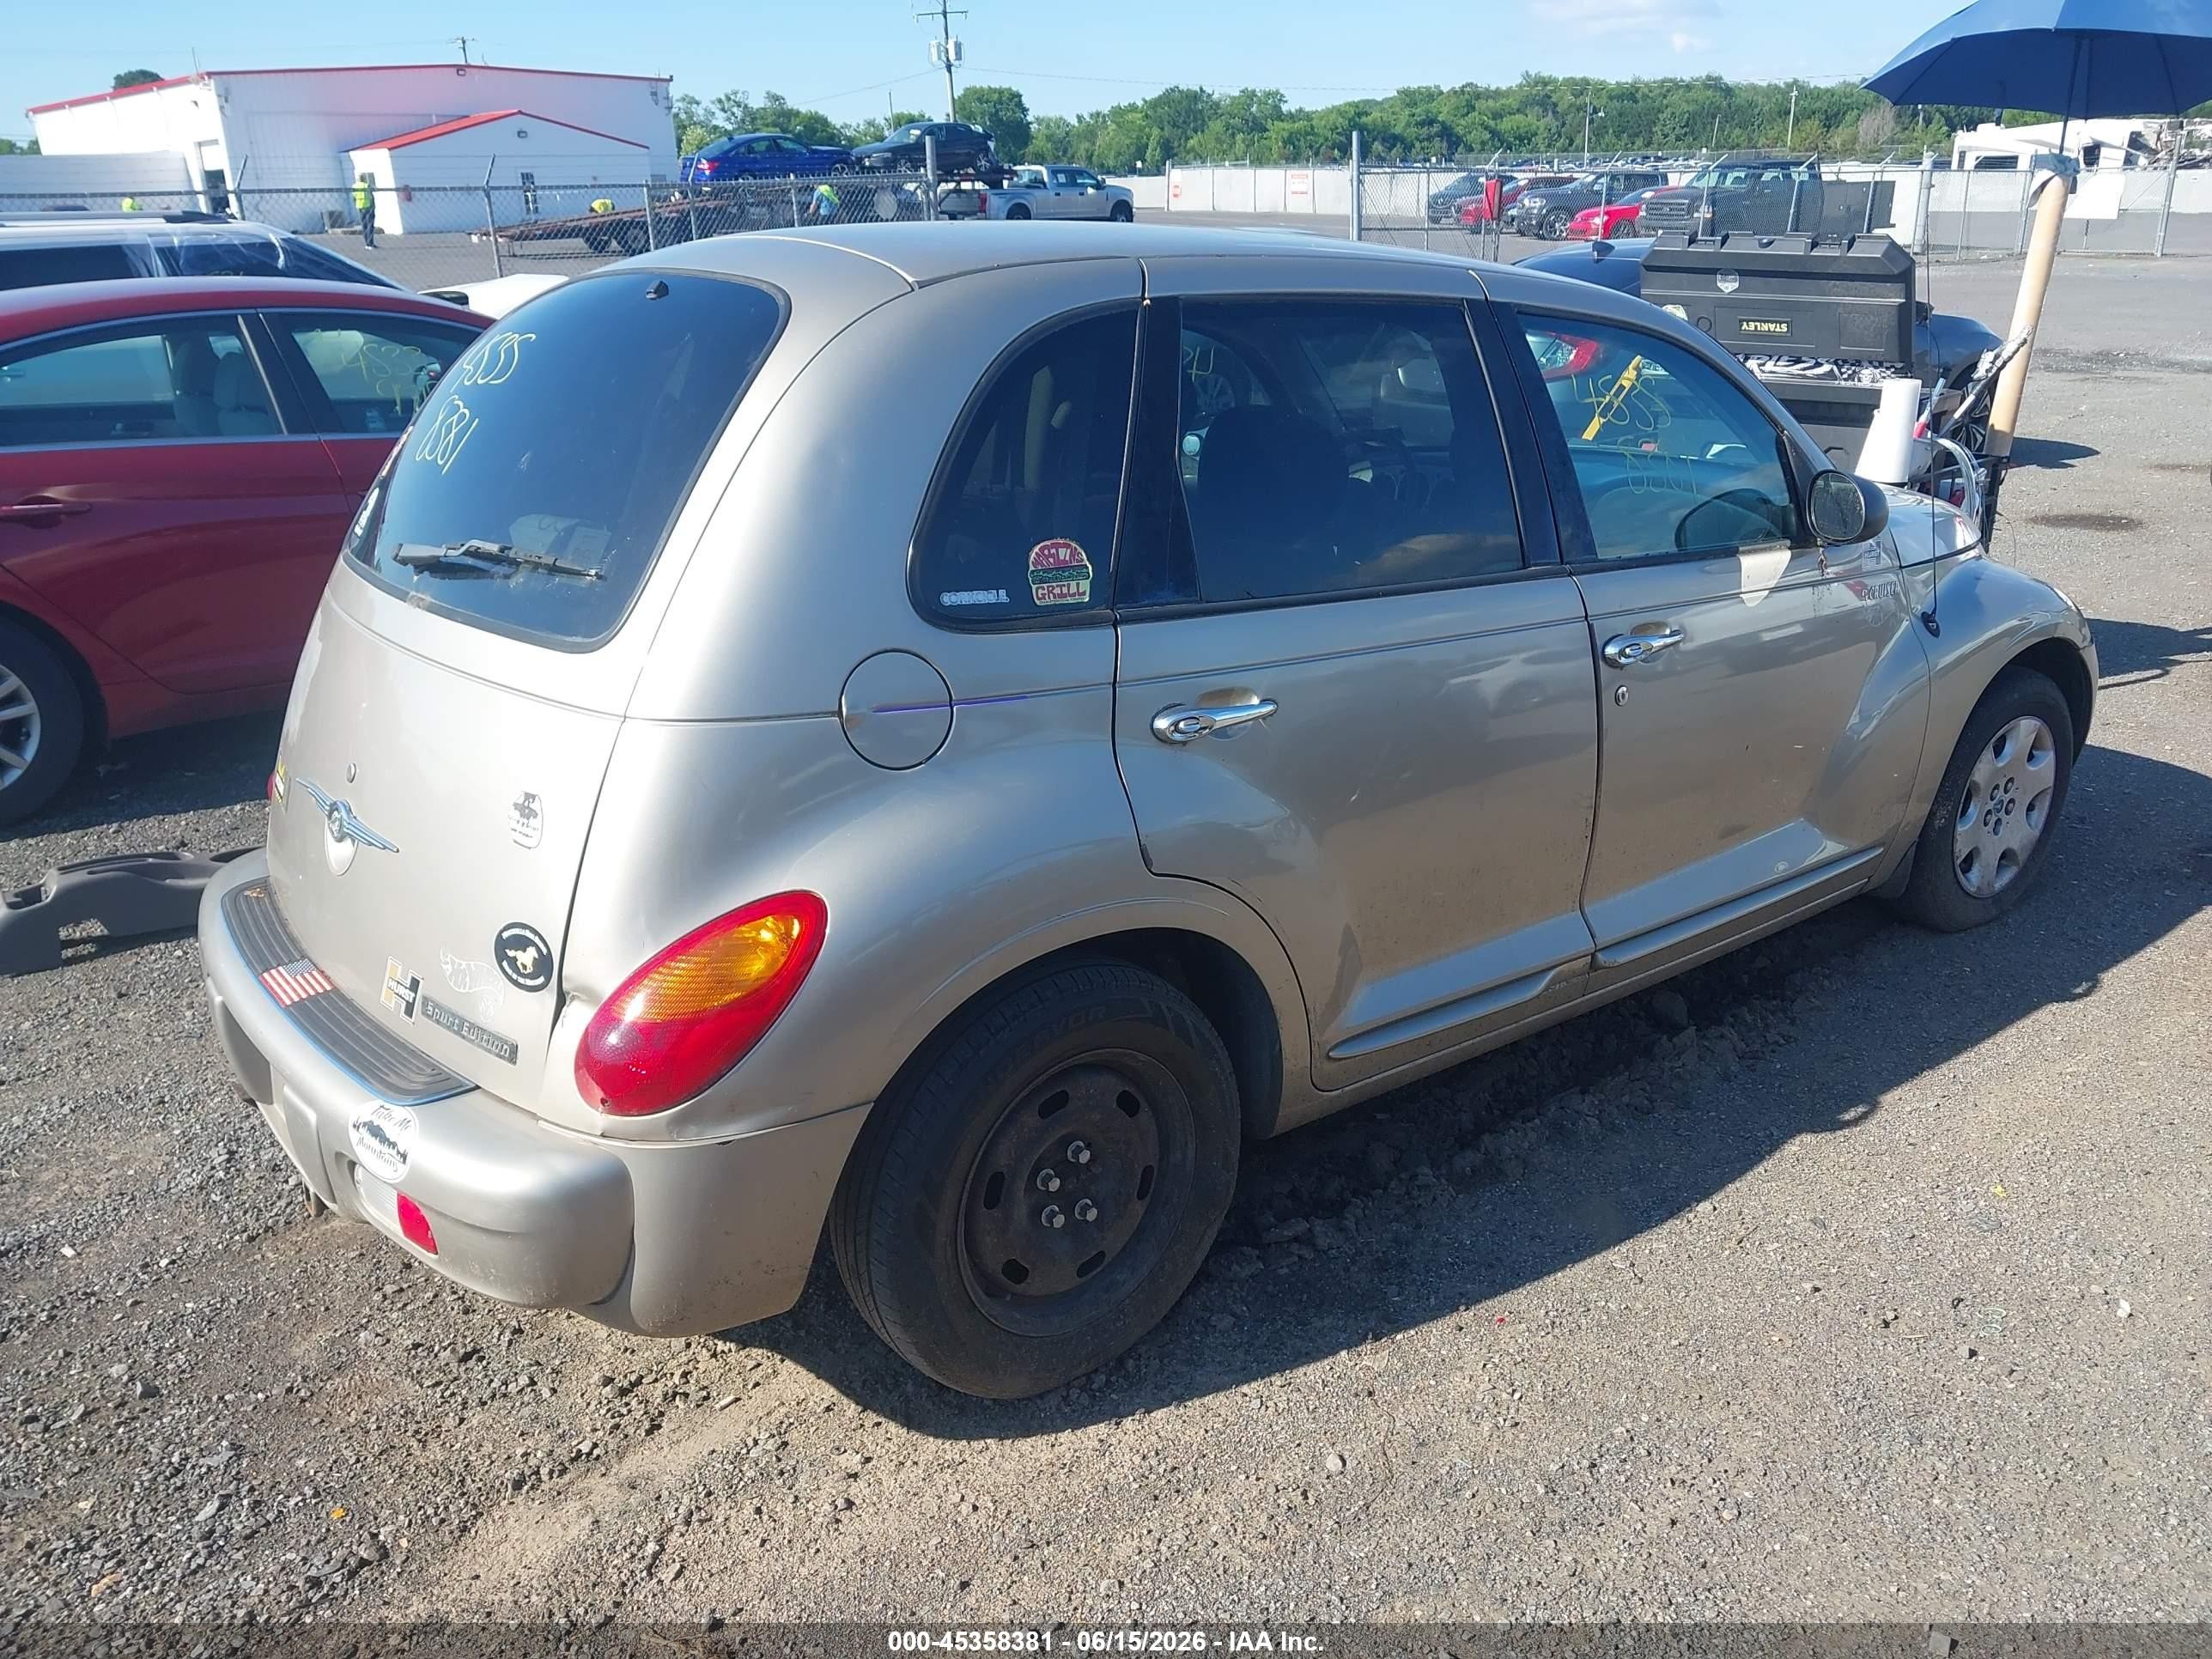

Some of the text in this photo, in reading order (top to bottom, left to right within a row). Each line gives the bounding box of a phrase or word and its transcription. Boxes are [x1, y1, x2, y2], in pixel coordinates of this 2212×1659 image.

[1741, 320, 1788, 332] STANLEY
[1031, 542, 1085, 568] MARTINS
[1035, 581, 1086, 601] GRILL
[387, 978, 416, 1003] HURST
[460, 1021, 511, 1058] Edition
